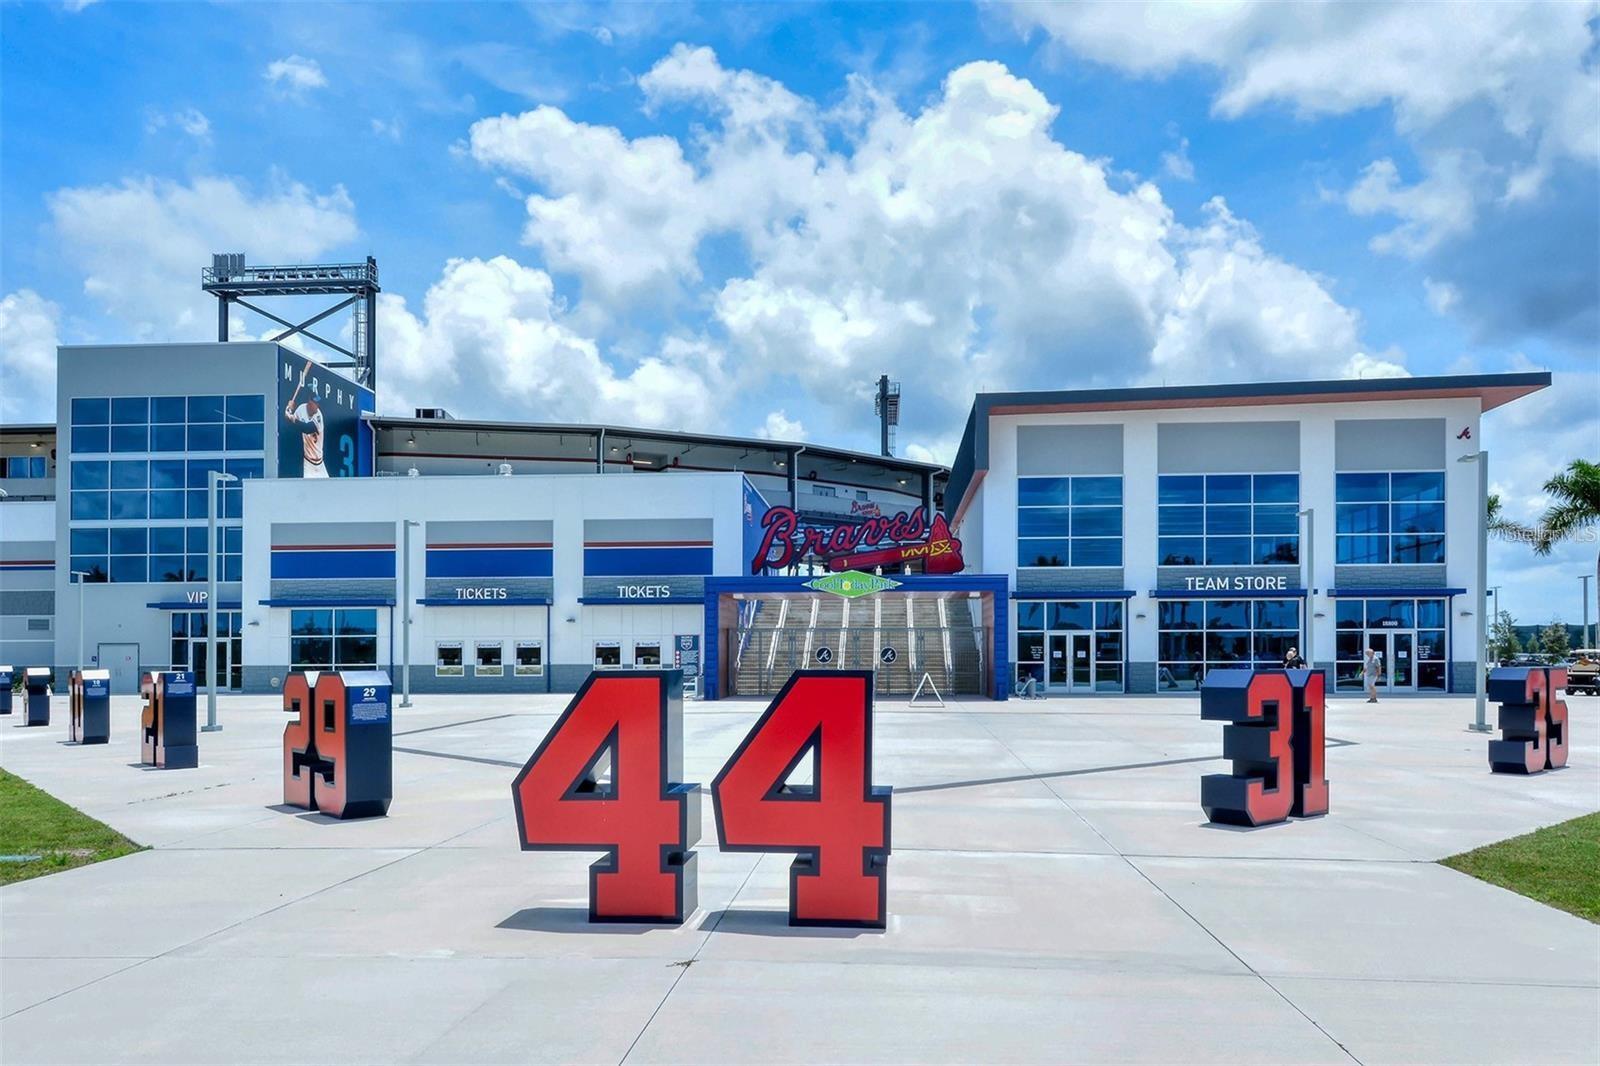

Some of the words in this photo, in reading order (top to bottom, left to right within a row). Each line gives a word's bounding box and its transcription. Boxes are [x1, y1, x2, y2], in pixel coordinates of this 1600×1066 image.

[339, 434, 354, 477] 3
[751, 505, 927, 575] Braves
[186, 591, 209, 604] VIP
[455, 588, 507, 600] TICKETS
[617, 585, 670, 599] TICKETS
[1185, 576, 1229, 591] TEAM
[1234, 576, 1287, 591] STORE
[363, 687, 376, 697] 29
[1522, 667, 1568, 774] 35
[283, 671, 347, 820] 29
[1244, 670, 1329, 826] 31
